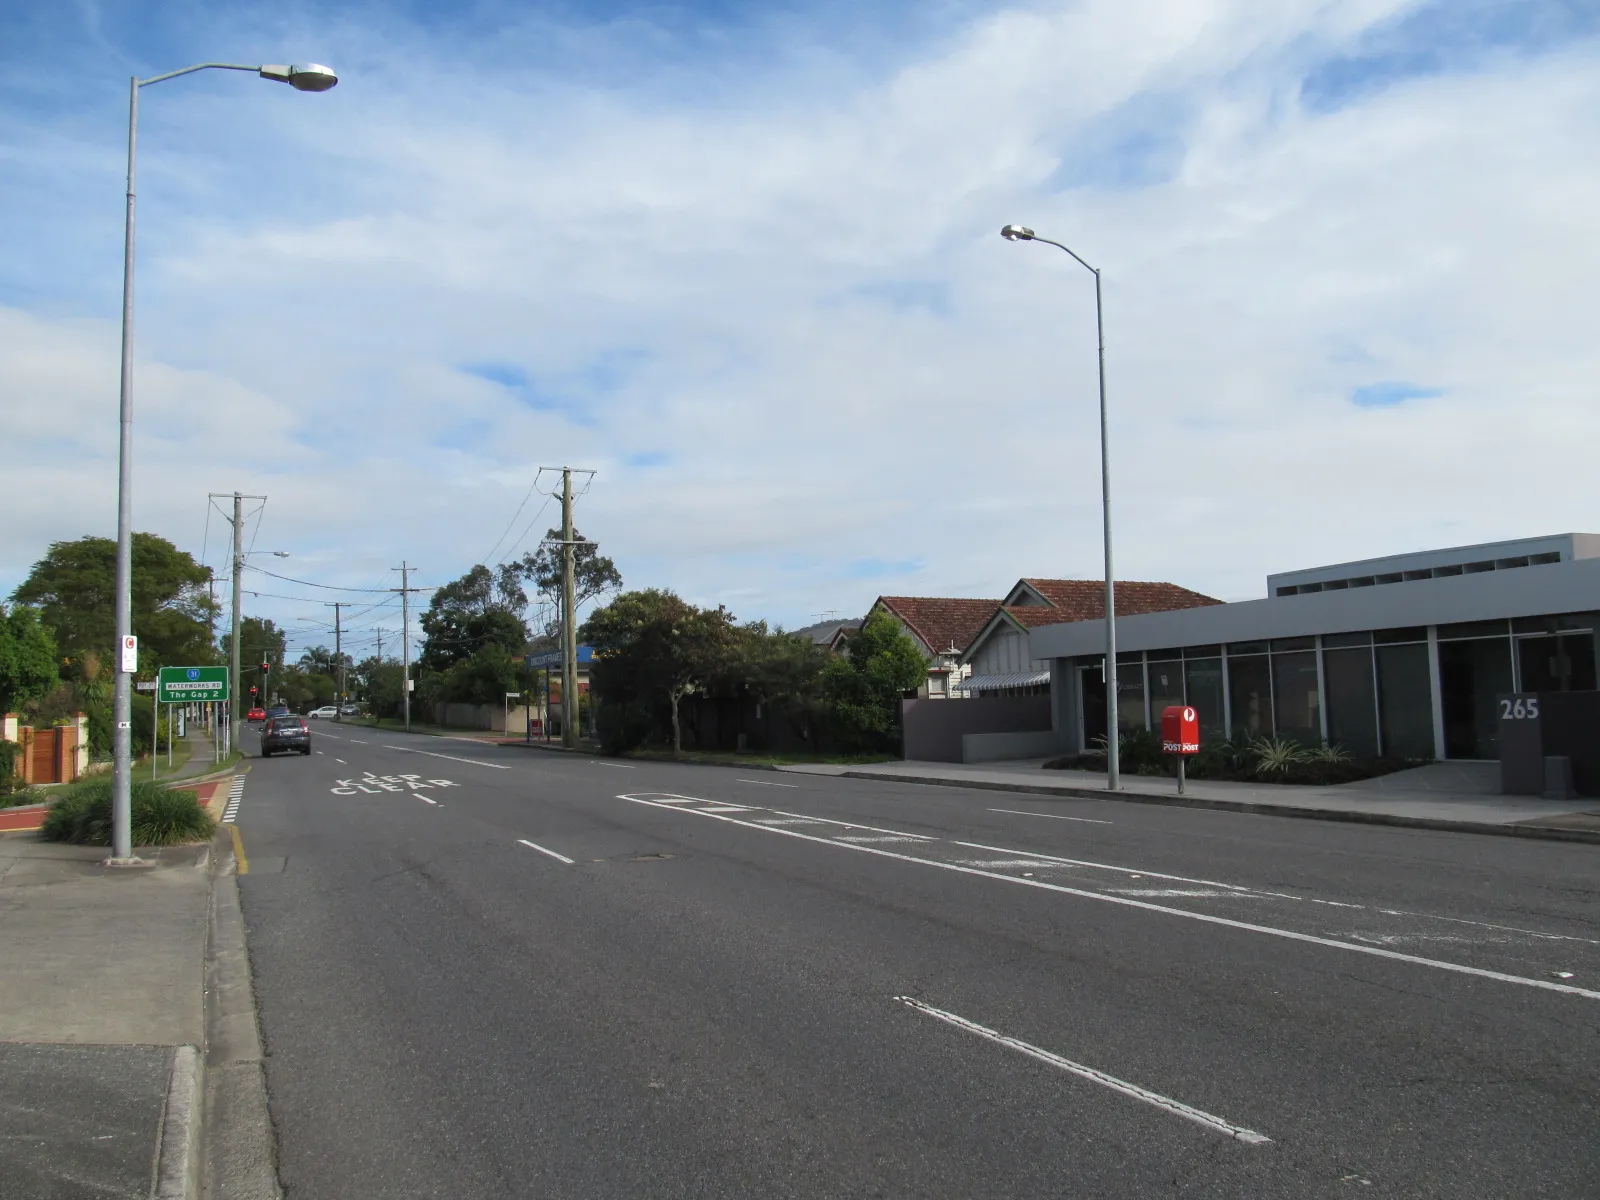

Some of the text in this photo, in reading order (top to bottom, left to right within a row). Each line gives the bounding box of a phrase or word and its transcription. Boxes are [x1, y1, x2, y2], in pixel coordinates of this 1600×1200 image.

[190, 670, 197, 678] 31
[190, 691, 208, 699] Gap
[1500, 698, 1539, 720] 265
[1163, 743, 1181, 751] POST
[336, 774, 421, 787] KEEP
[330, 779, 461, 795] CLEAR
